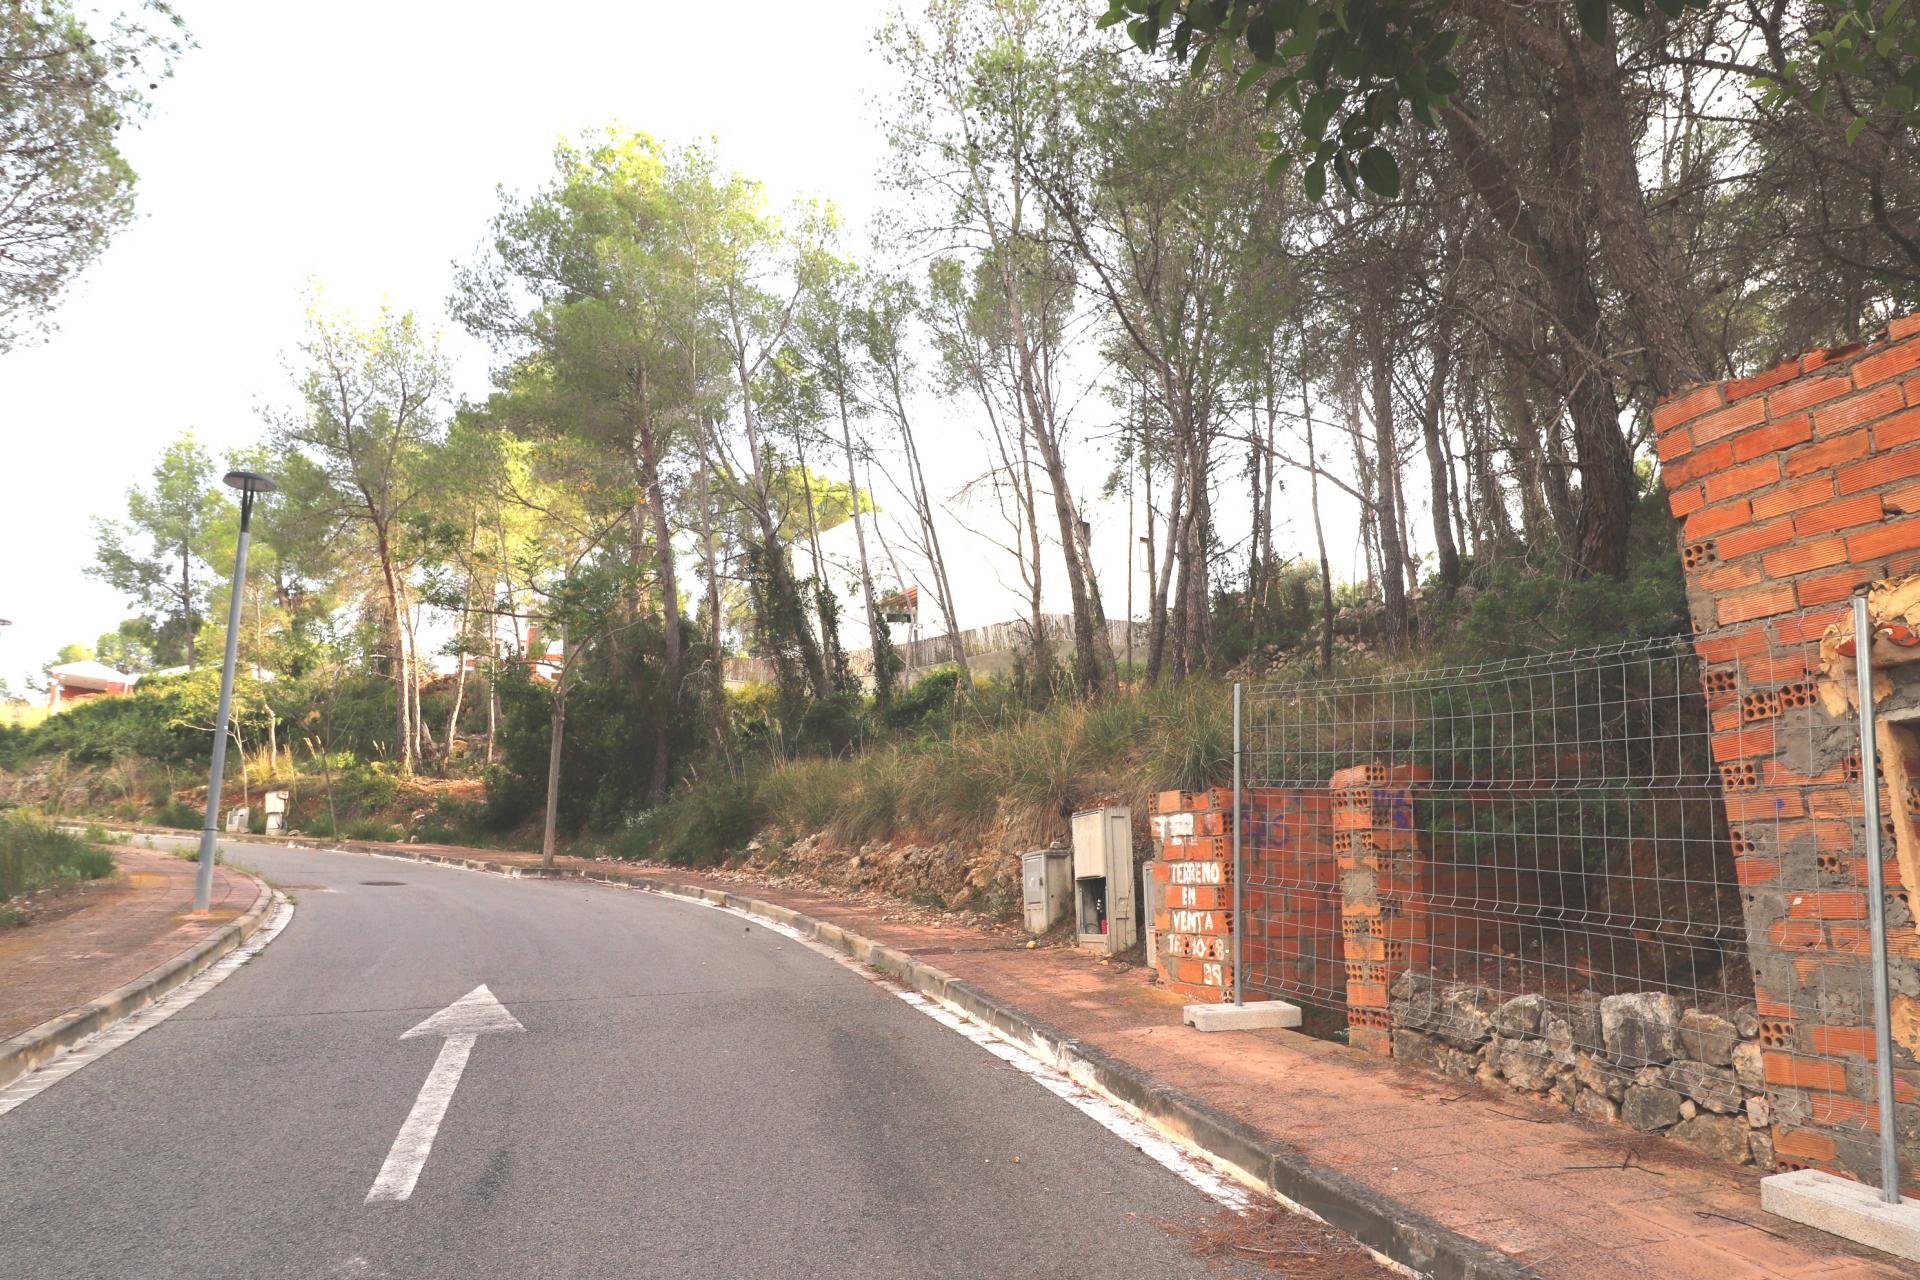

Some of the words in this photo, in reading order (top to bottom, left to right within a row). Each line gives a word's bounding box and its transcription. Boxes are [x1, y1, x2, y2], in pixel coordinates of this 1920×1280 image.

[1170, 862, 1220, 885] TERRENO
[1181, 886, 1196, 906] EN
[1172, 910, 1213, 933] VENTA
